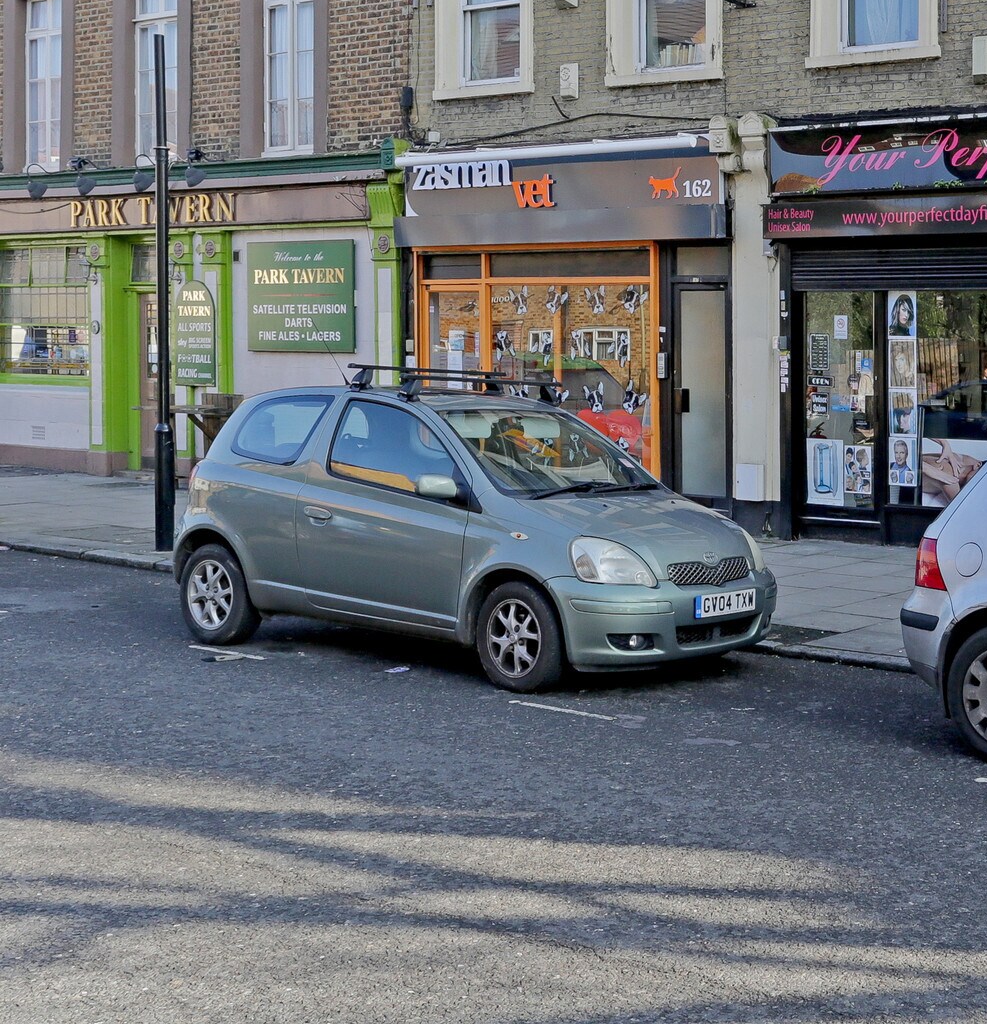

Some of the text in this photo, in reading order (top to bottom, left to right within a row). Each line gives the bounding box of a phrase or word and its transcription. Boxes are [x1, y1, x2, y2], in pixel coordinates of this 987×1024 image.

[816, 134, 906, 186] Your
[412, 159, 555, 208] zasman vet
[683, 179, 712, 198] 162
[70, 192, 237, 227] PARK TVERN
[768, 208, 814, 221] Hair & Beauty
[768, 221, 811, 232] Unisex Salon
[273, 251, 324, 263] Welcome to the
[254, 267, 345, 285] PARK TAVERN
[182, 290, 206, 302] PARK
[177, 305, 211, 317] TAVERN
[253, 303, 347, 315] SATELLITE TELEVISION
[177, 322, 212, 332] ALL SPORTS
[284, 317, 313, 328] DARTS
[258, 331, 277, 341] FINE
[278, 331, 300, 341] ALES
[177, 367, 198, 378] RACING
[811, 377, 830, 386] OPEN
[703, 591, 754, 613] GV04 TXW
